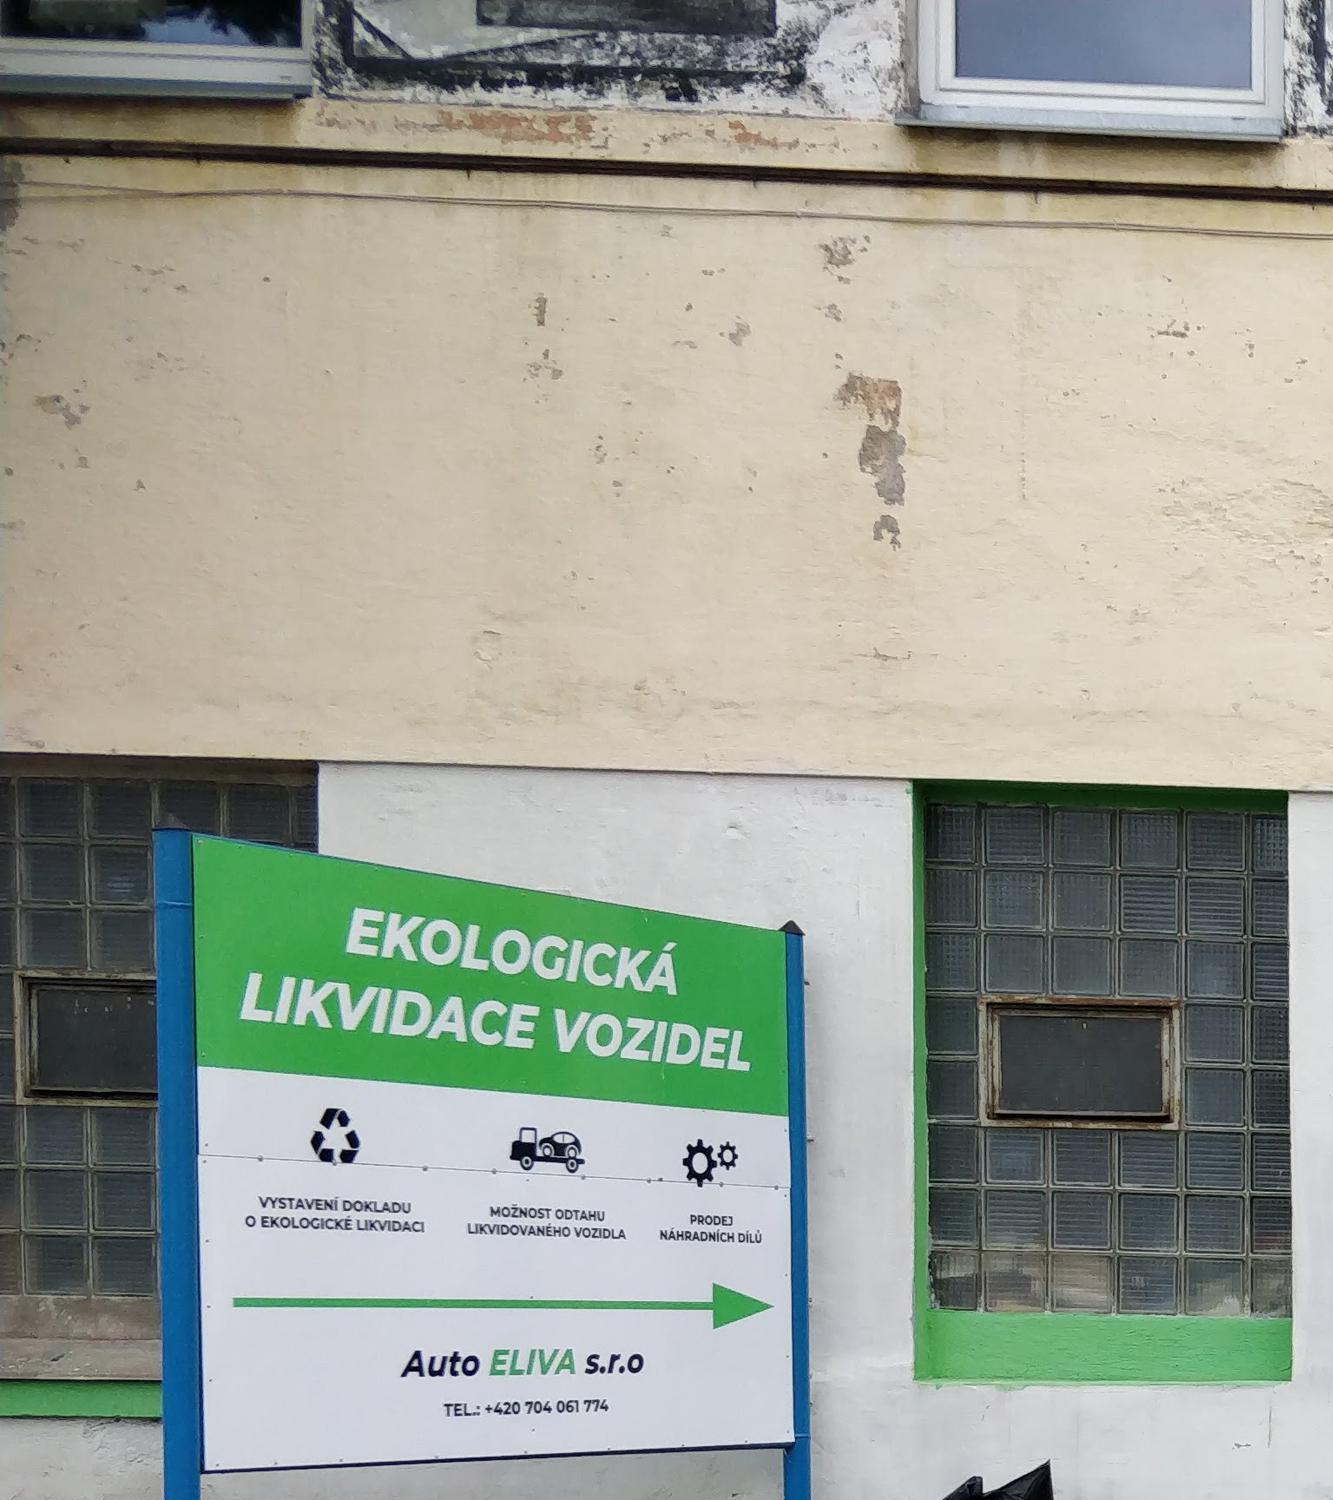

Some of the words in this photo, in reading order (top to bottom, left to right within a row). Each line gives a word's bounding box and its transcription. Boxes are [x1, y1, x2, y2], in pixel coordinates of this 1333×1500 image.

[345, 907, 679, 995] EKOLOGICKÁ
[241, 972, 539, 1048] LIKVIDACE
[555, 1009, 751, 1072] VOZIDEL
[259, 1197, 338, 1211] VYSTAVENÍ
[343, 1200, 411, 1213] DOKLADU
[490, 1204, 552, 1219] MOŽNOST
[555, 1209, 604, 1221] ODTAHU
[245, 1216, 256, 1227] O
[261, 1213, 352, 1230] EKOLOGICKÉ
[357, 1220, 424, 1232] LIKVIDACI
[468, 1220, 572, 1237] LIKVIDOVANÉHO
[574, 1227, 626, 1239] VOZIDLA
[690, 1215, 733, 1226] PRODEJ
[660, 1229, 734, 1242] NÁHRADNÍCH
[738, 1230, 761, 1243] DÍLŮ
[400, 1350, 480, 1377] Auto
[489, 1349, 575, 1376] ELIVA
[585, 1354, 644, 1374] s.r.o
[485, 1402, 520, 1415] +420
[525, 1401, 552, 1414] 704
[556, 1400, 579, 1413] 061
[584, 1399, 609, 1412] 774
